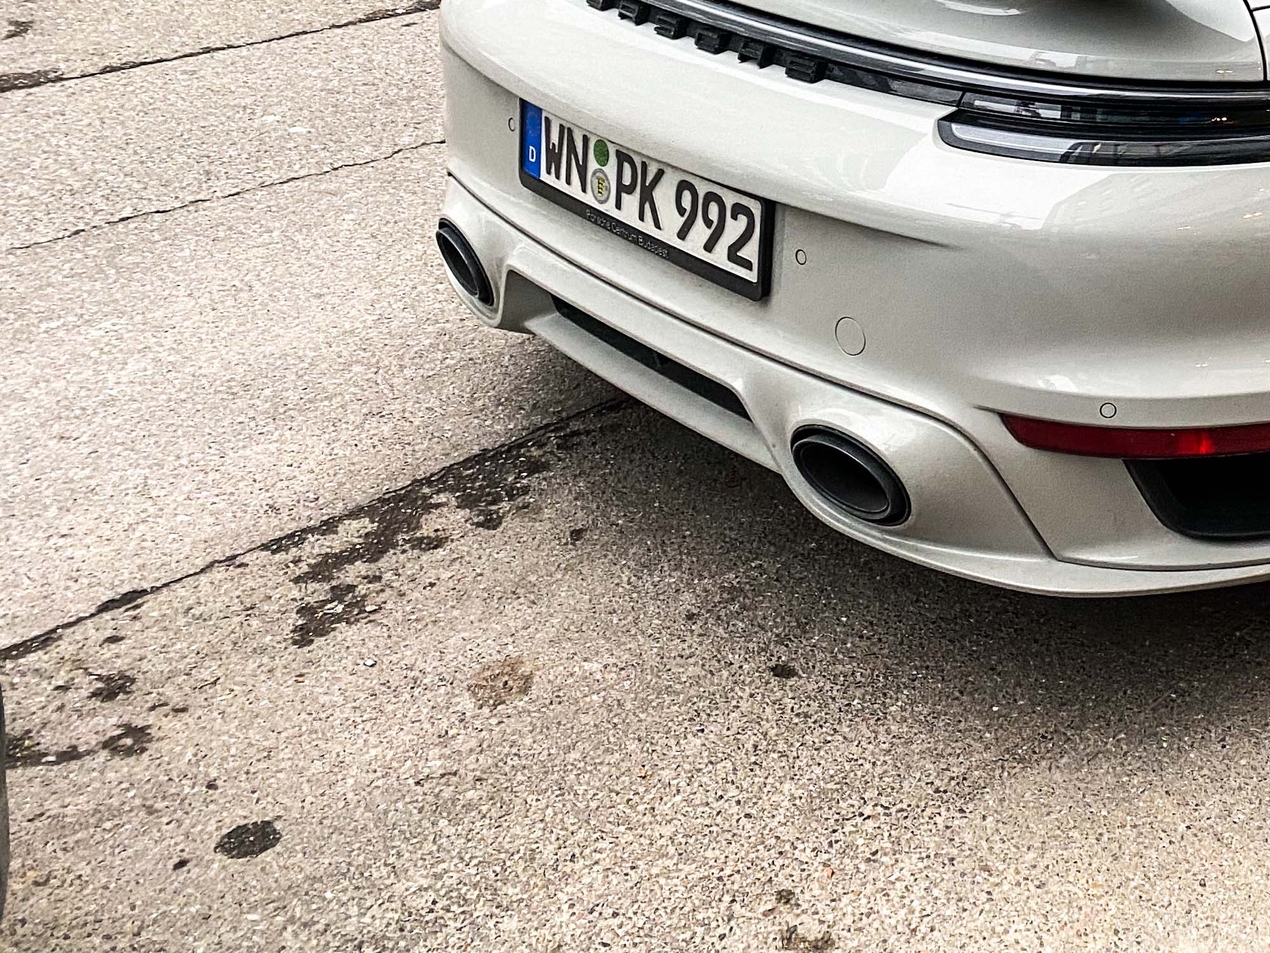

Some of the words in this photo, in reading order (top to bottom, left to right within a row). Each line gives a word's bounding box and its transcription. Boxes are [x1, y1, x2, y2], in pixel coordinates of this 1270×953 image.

[528, 145, 536, 163] D
[544, 116, 589, 193] WN
[614, 148, 665, 231] PK
[675, 179, 755, 272] 992
